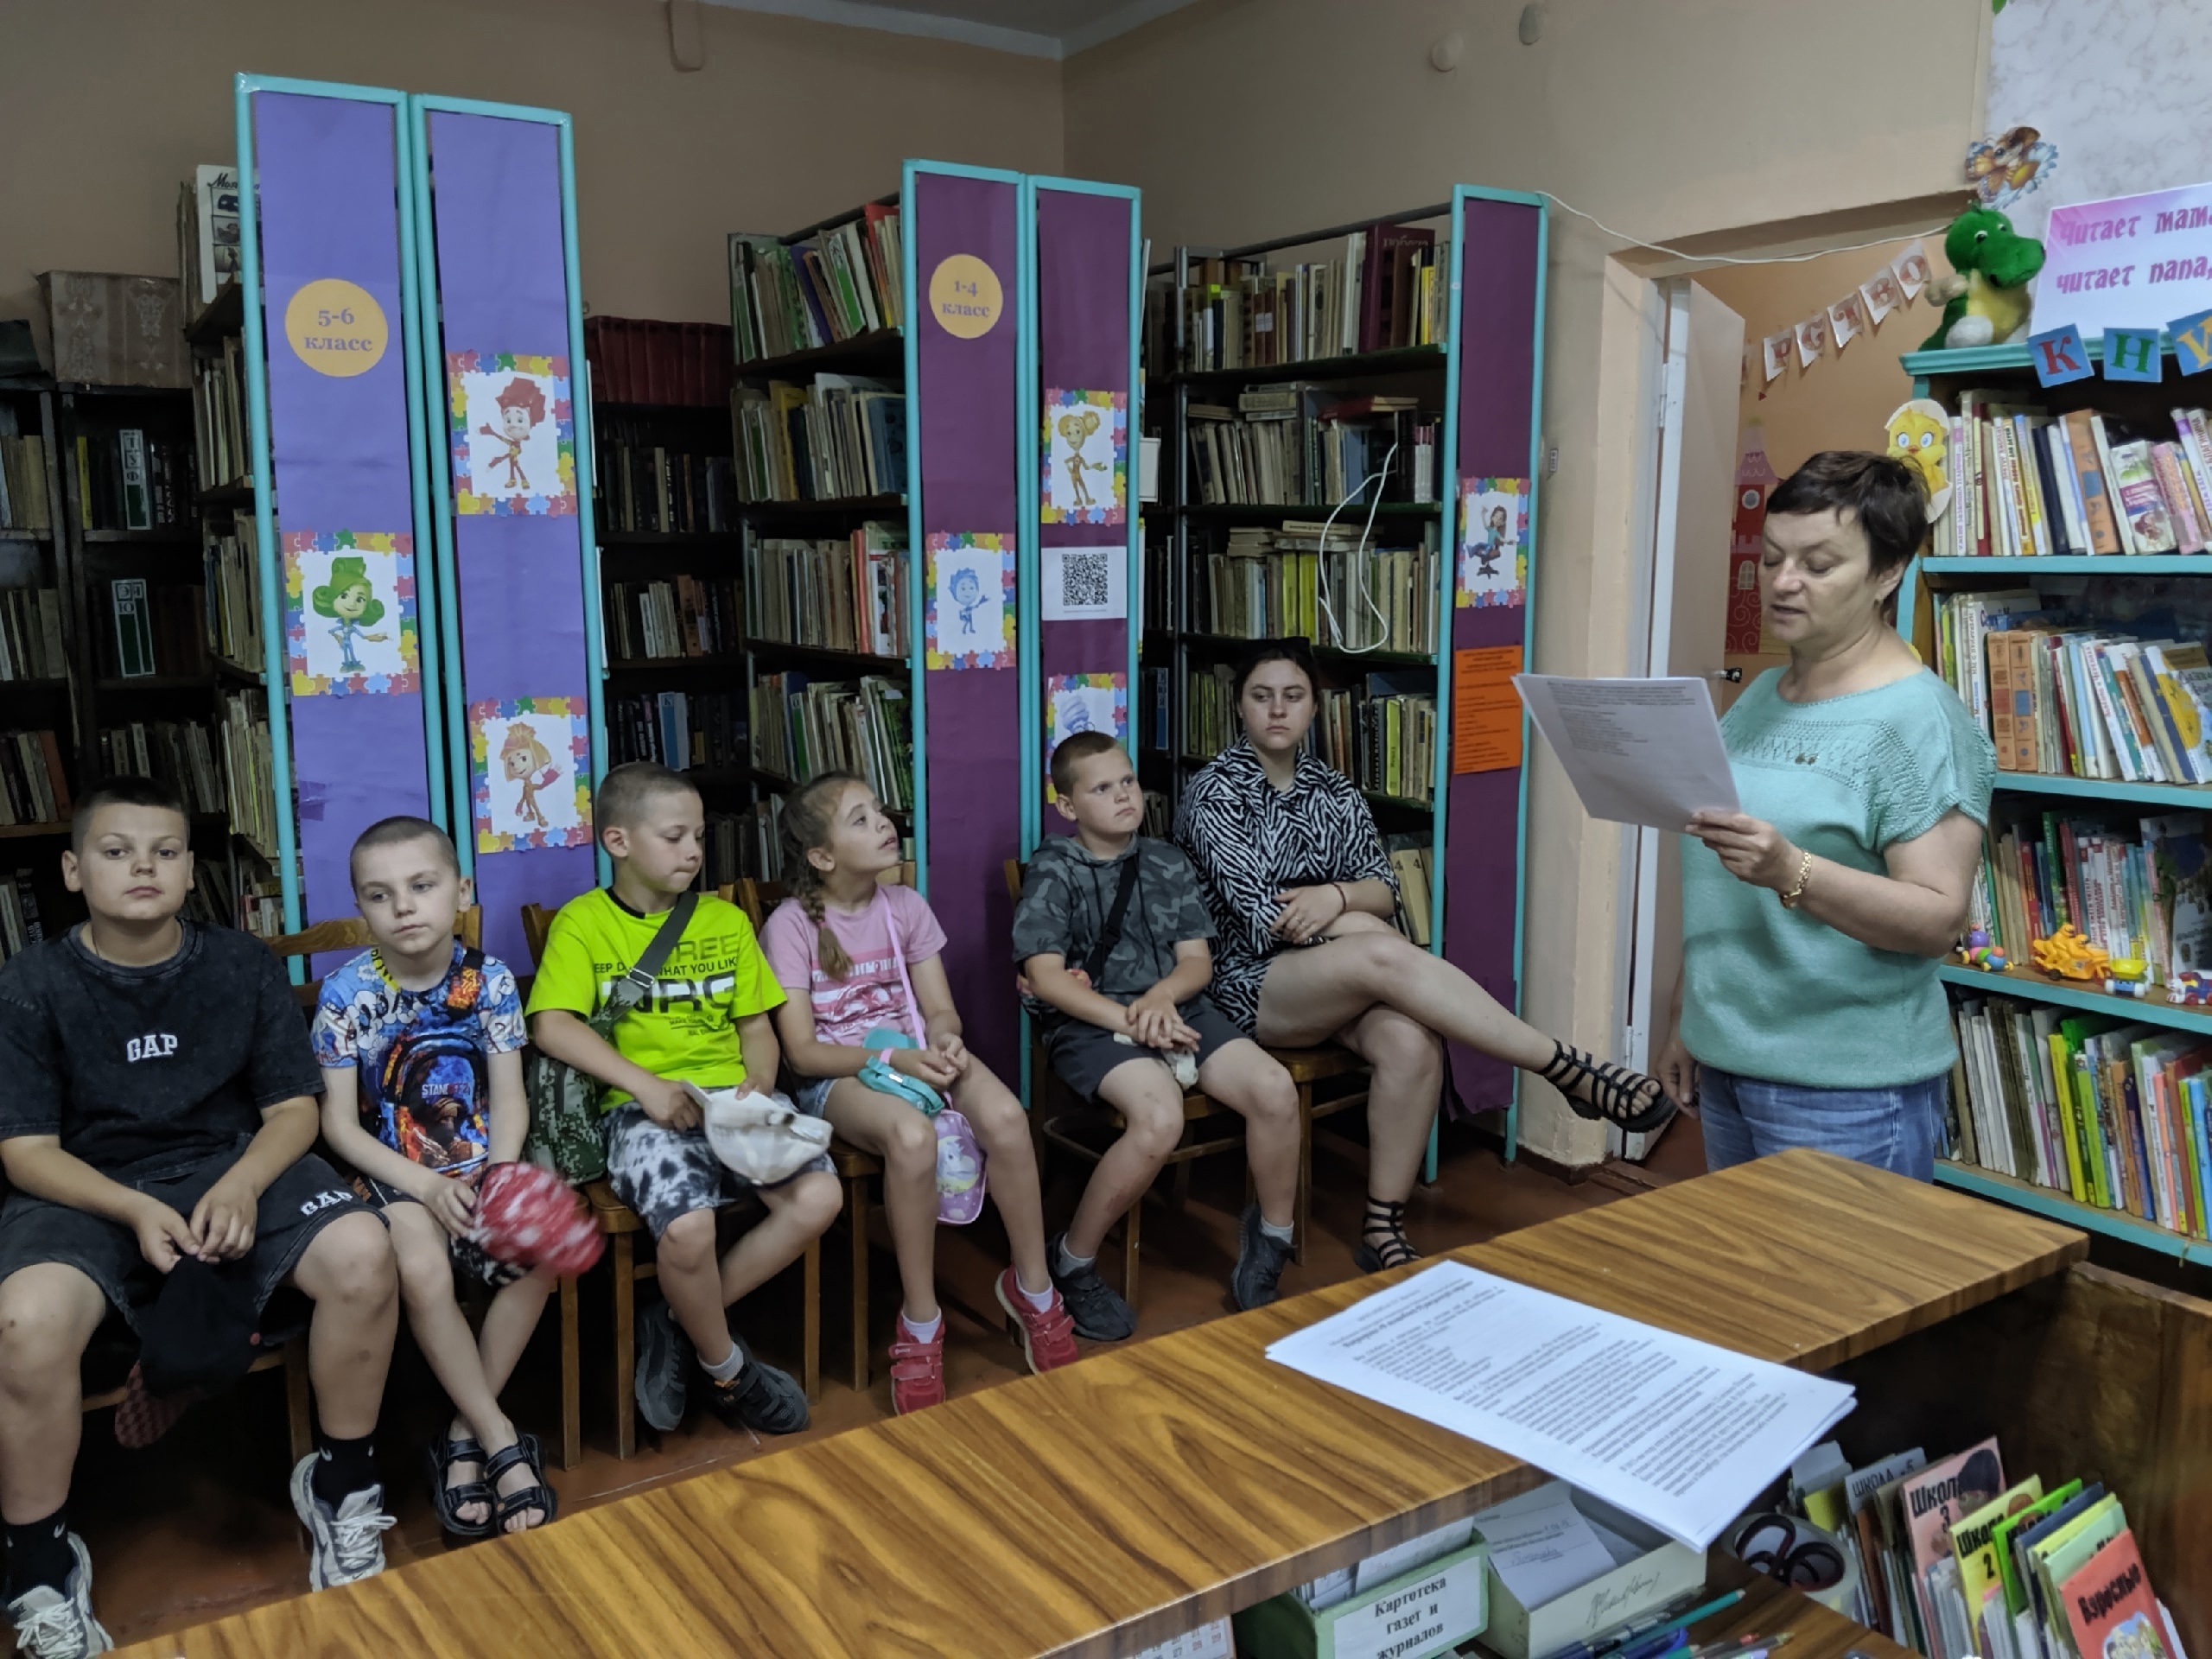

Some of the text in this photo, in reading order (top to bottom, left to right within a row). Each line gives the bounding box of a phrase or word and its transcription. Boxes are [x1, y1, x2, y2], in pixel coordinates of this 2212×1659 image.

[2059, 204, 2212, 246] Читает мам
[954, 280, 977, 297] 1-4
[2056, 264, 2135, 295] читает
[317, 308, 355, 327] 5-6
[941, 302, 991, 318] класс
[303, 336, 373, 353] класс
[675, 932, 741, 963] REE
[594, 963, 613, 973] EEP
[690, 960, 715, 974] YOU
[717, 956, 737, 970] LIK
[126, 1034, 178, 1063] GAP
[1852, 1467, 1895, 1498] ШКОЛА
[1940, 1504, 1951, 1534] 3
[1983, 1553, 1995, 1580] 2
[1374, 1576, 1447, 1618] Картотека
[1386, 1602, 1440, 1636] газет и
[1376, 1622, 1445, 1659] журналов
